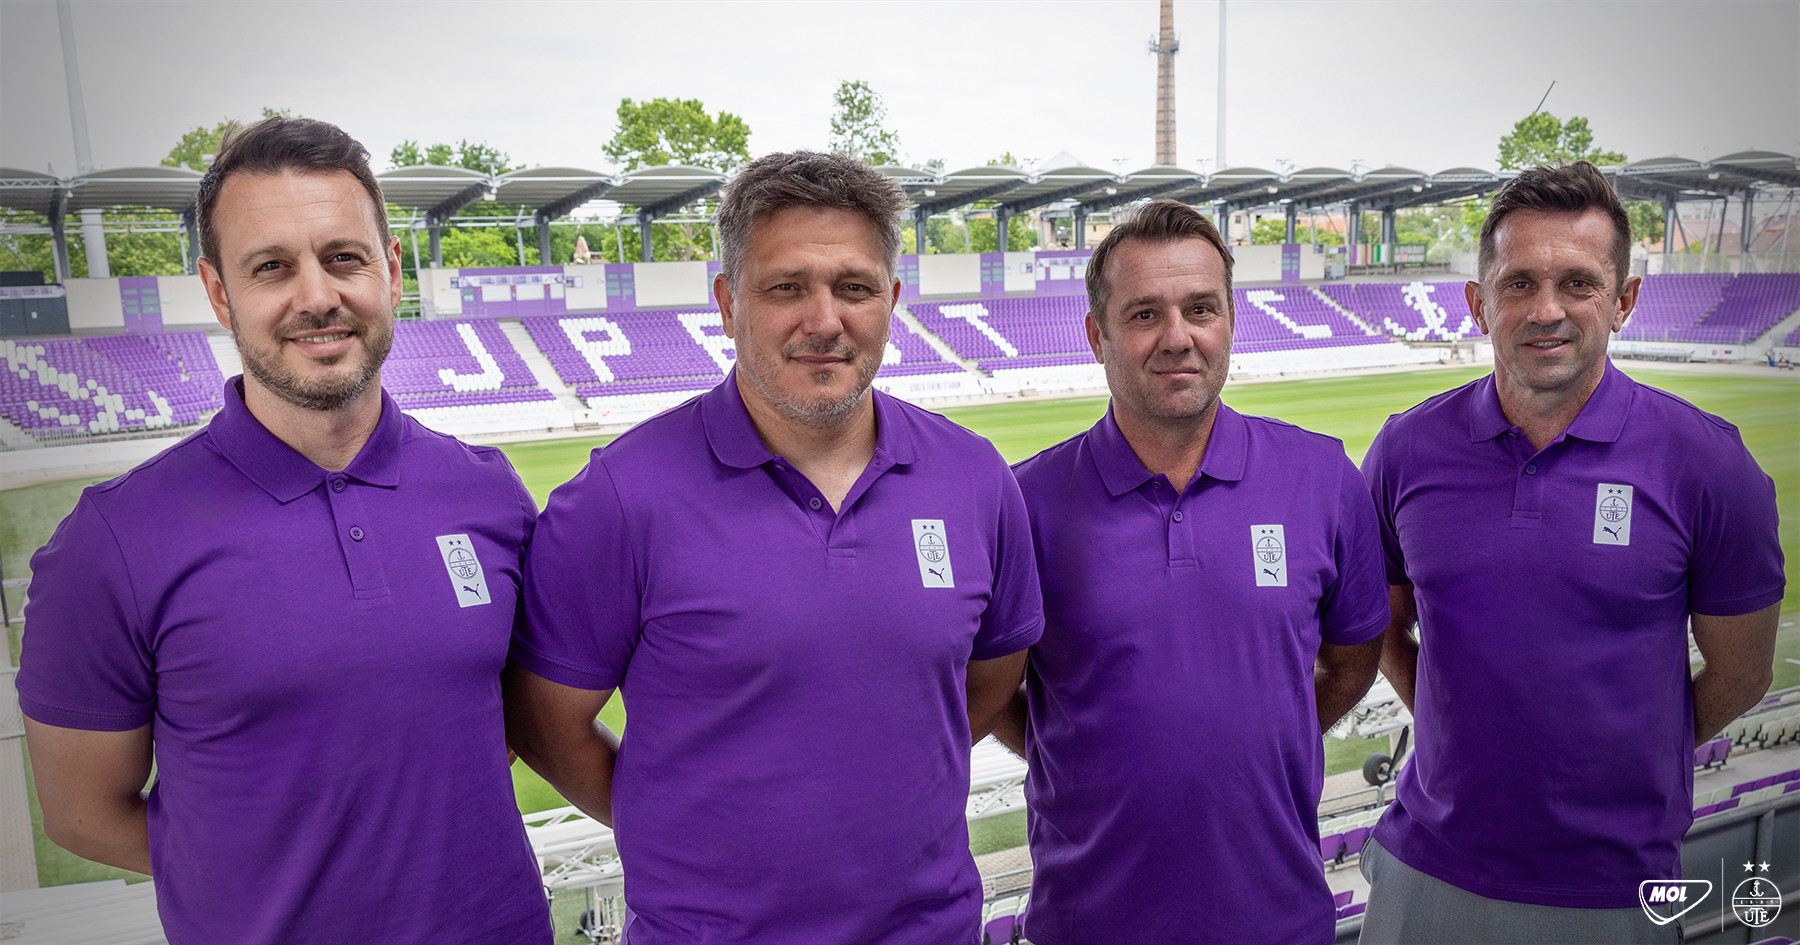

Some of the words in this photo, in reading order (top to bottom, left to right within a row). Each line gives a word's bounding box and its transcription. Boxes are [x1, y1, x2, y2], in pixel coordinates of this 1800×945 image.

[1606, 511, 1620, 521] UTE
[927, 550, 940, 561] UTE
[1263, 551, 1277, 562] UTE
[459, 565, 473, 577] UTE
